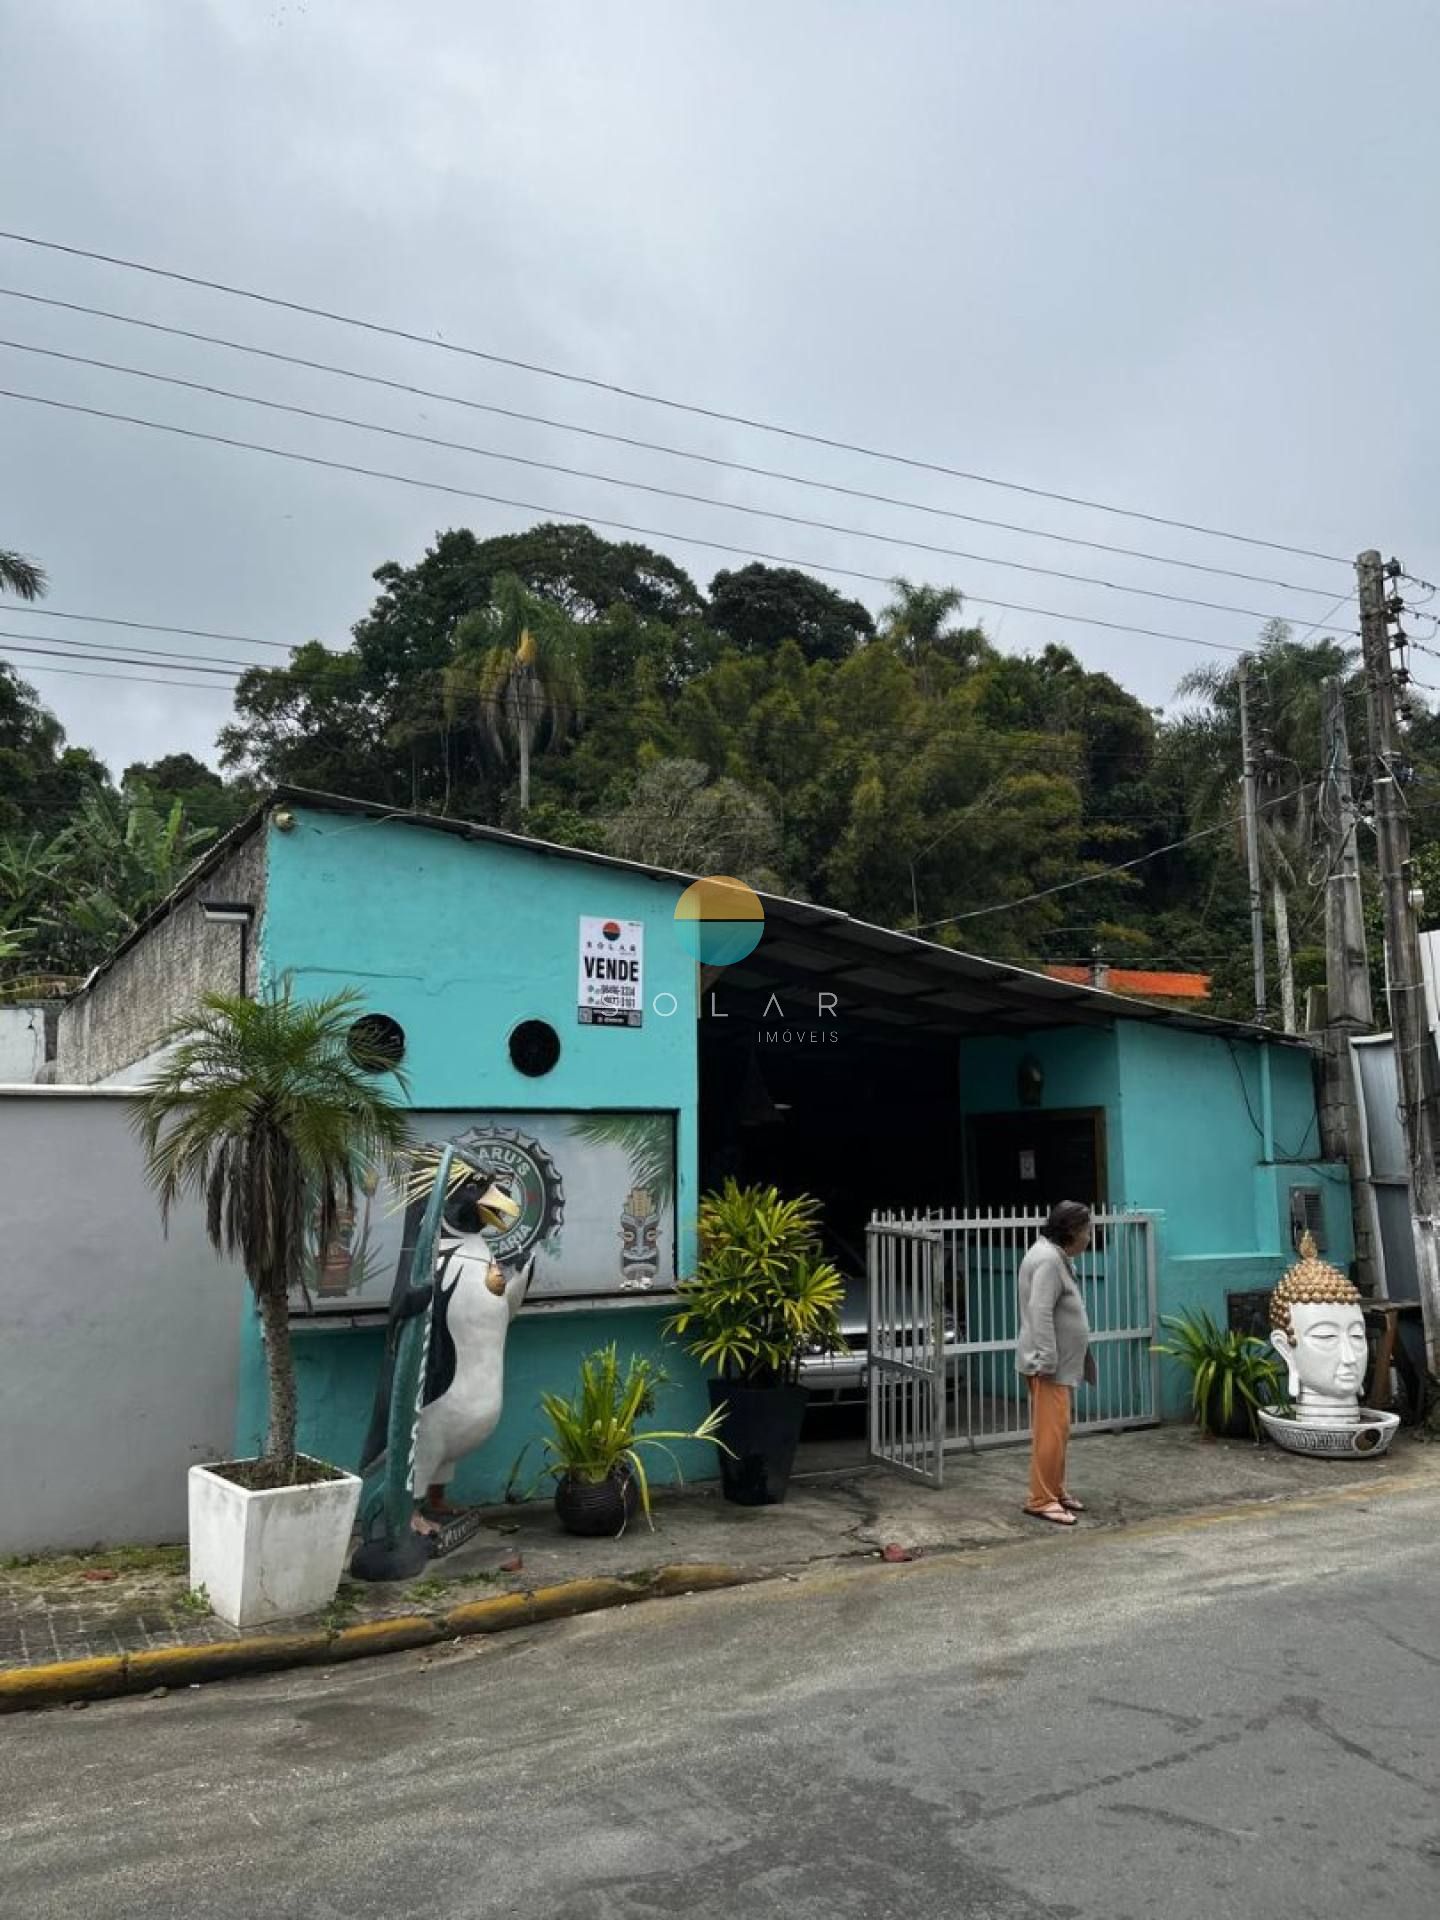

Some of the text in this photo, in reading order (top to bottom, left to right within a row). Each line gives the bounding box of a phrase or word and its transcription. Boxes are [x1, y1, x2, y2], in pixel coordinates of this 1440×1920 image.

[584, 956, 639, 982] VENDE
[478, 1146, 531, 1176] ARU'S
[488, 1224, 533, 1252] CARIA
